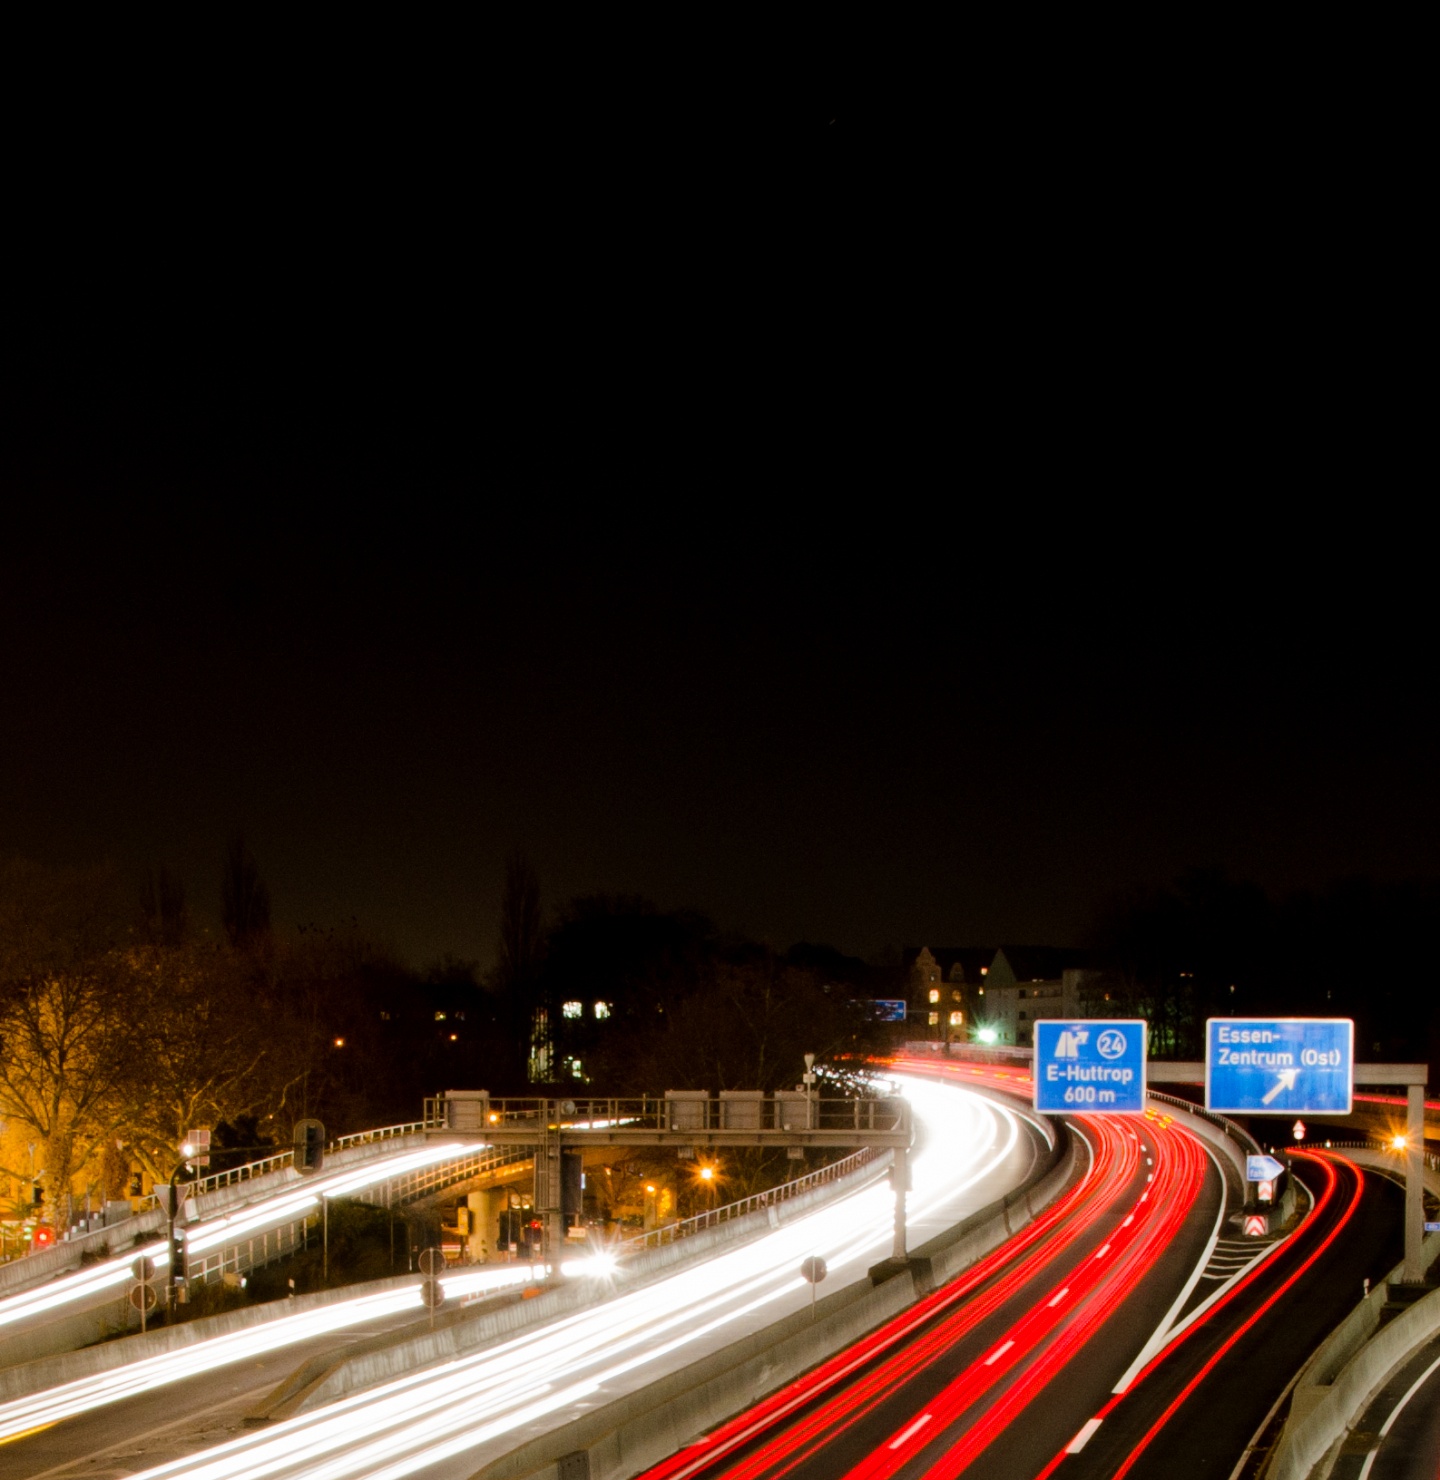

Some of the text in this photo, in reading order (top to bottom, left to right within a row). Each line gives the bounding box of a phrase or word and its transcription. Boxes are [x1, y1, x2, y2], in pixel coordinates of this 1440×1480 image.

[1218, 1027, 1280, 1043] Essen-
[1101, 1036, 1121, 1053] 24
[1218, 1048, 1340, 1067] Zentrum (Ost)
[1047, 1065, 1133, 1085] E-Huttrop
[1064, 1086, 1115, 1103] 600 m
